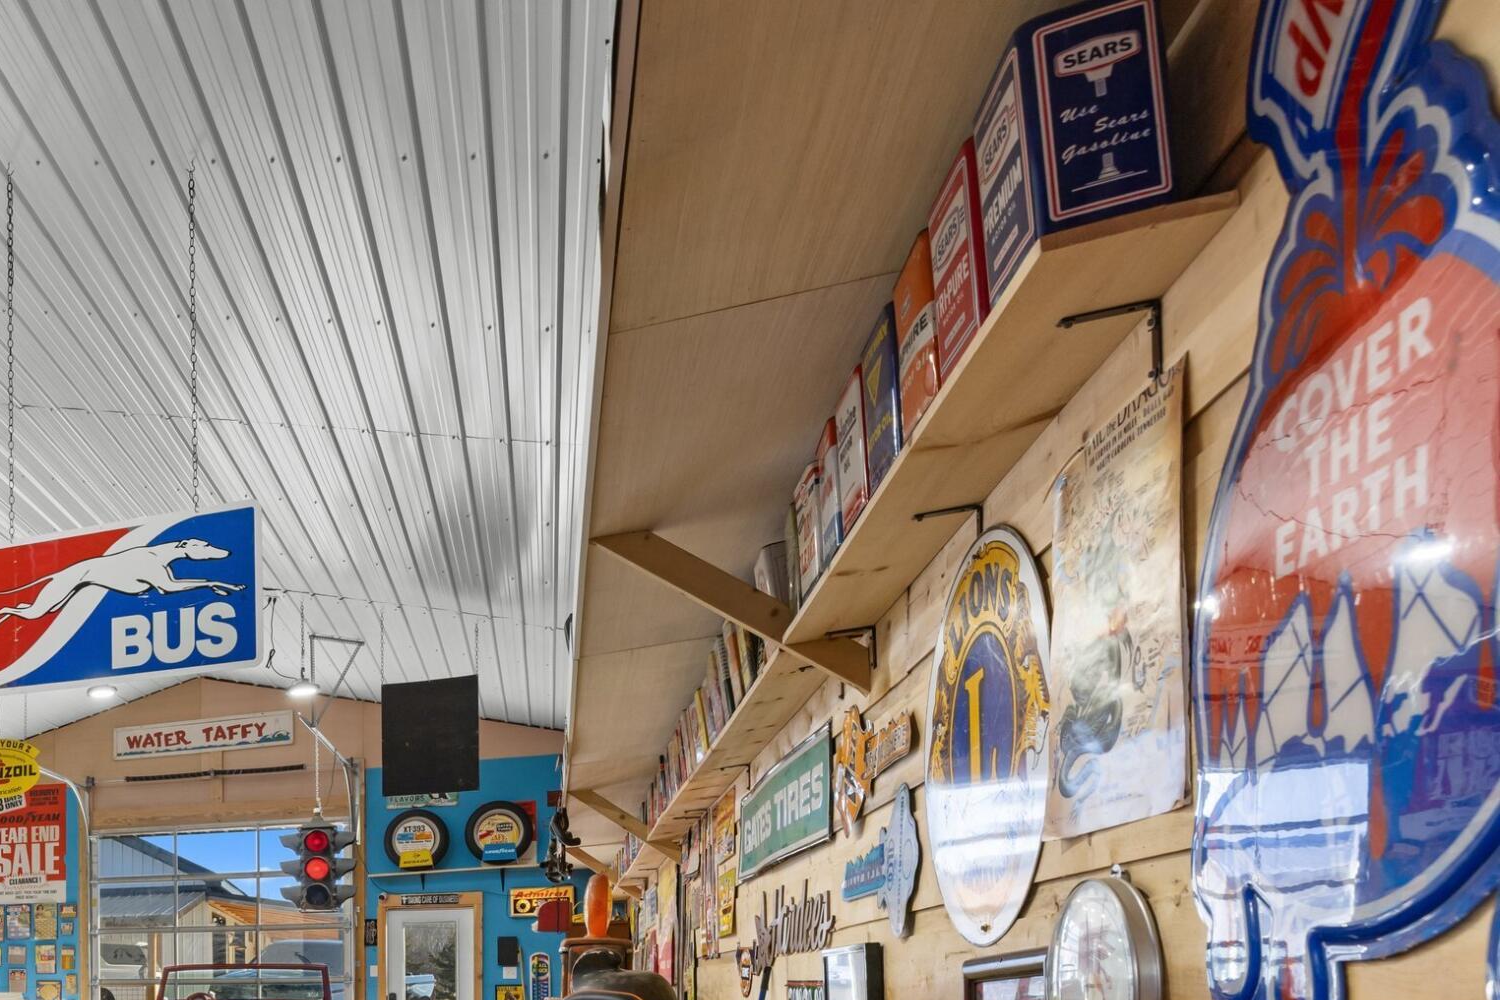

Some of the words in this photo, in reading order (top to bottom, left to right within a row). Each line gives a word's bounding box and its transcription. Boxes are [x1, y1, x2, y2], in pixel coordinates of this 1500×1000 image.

[1063, 37, 1133, 69] SEARS
[1060, 105, 1099, 123] Use
[1094, 110, 1149, 133] Sears
[984, 115, 1009, 169] SEARS
[1061, 128, 1151, 165] Gasoline
[983, 156, 1023, 241] PREMIUM
[937, 217, 959, 260] SEARS
[936, 252, 970, 321] TRI-PURE
[1274, 297, 1434, 454] COVER
[1302, 393, 1394, 494] THE
[1274, 444, 1430, 580] EARTH
[947, 562, 1015, 649] LIONS
[111, 602, 238, 669] BUS
[0, 740, 25, 750] YOUR
[126, 730, 192, 750] WATER
[202, 721, 268, 743] TAFFY
[964, 666, 999, 786] L
[5, 799, 24, 810] ONLY
[744, 800, 772, 856] GATES
[773, 762, 824, 831] TIRES
[31, 825, 60, 842] END
[514, 889, 568, 898] Admiral
